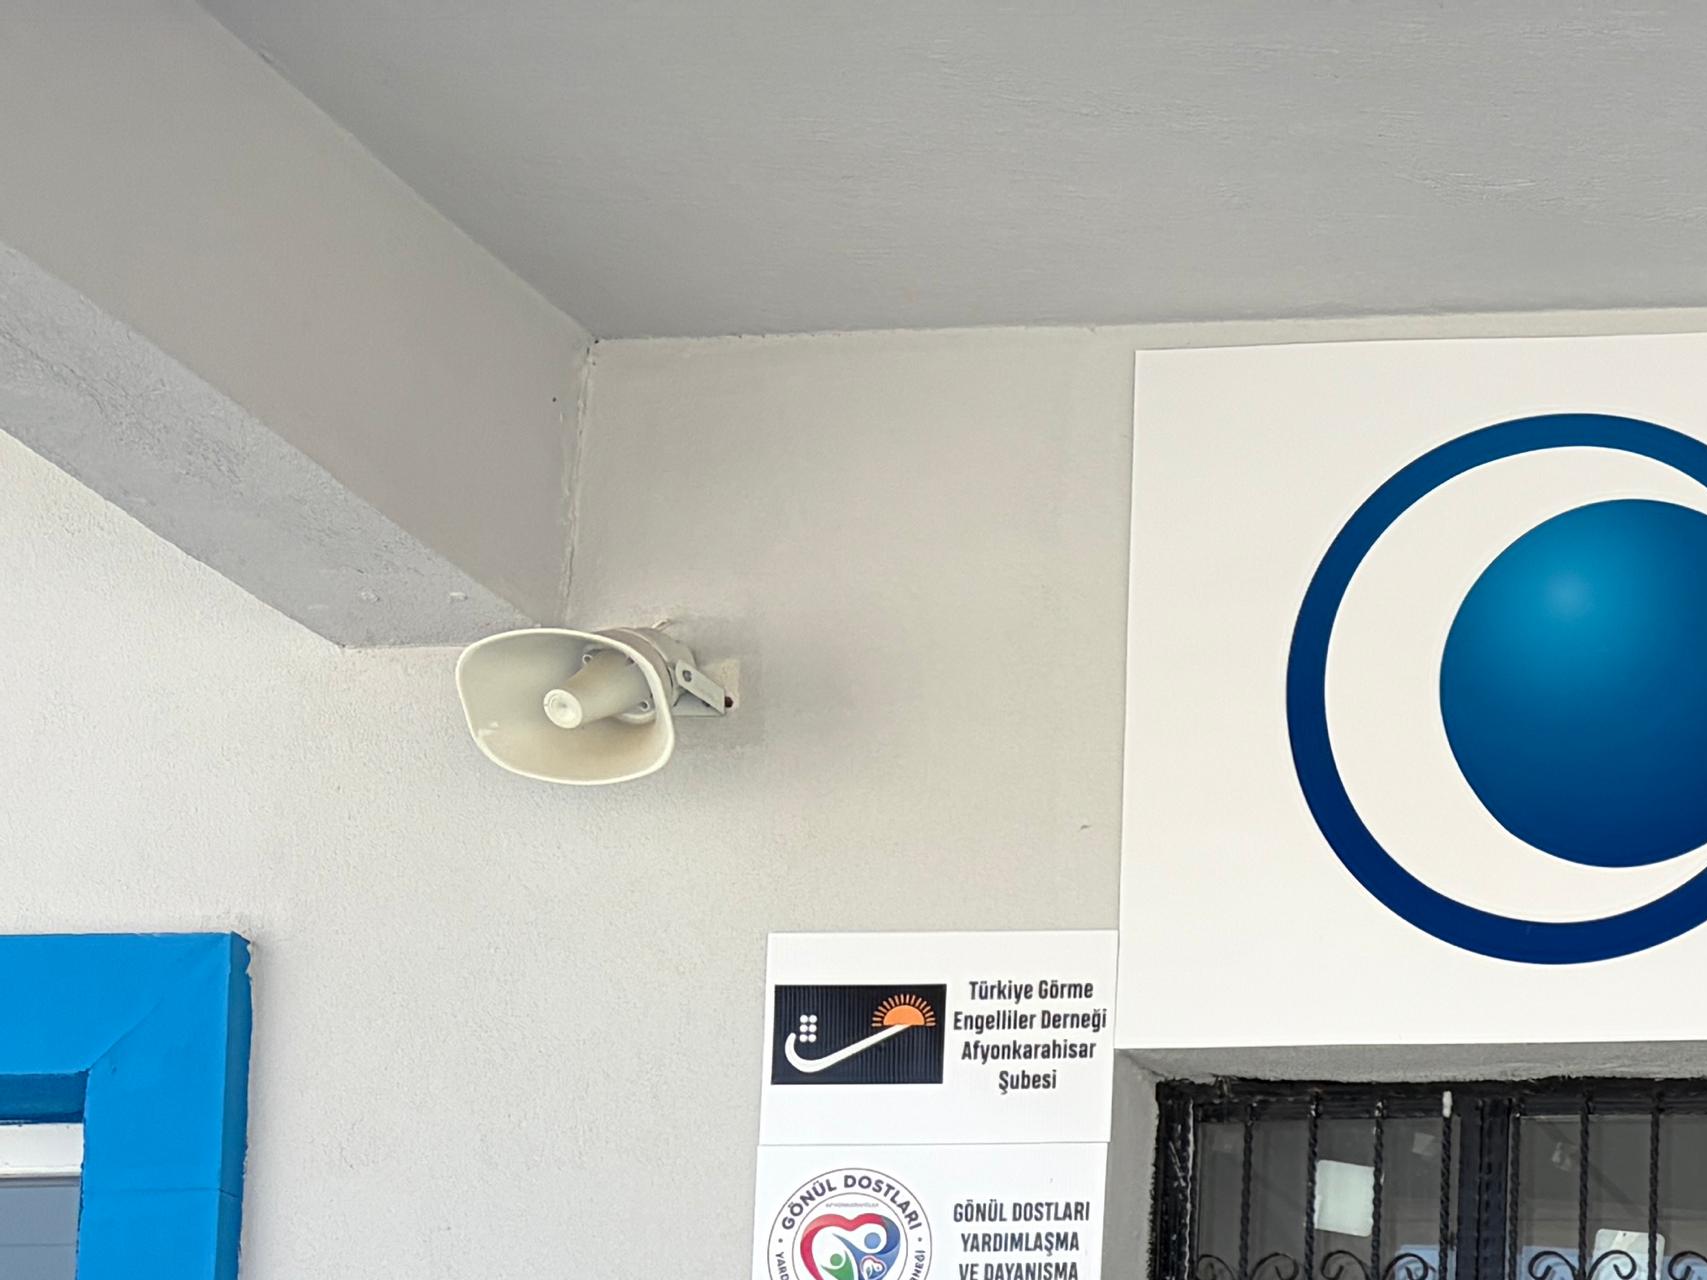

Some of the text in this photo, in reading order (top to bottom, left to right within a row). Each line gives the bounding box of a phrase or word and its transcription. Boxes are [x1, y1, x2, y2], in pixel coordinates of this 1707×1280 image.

[969, 979, 1094, 1004] Türkiye Görme
[953, 1008, 1107, 1034] Engelliler Derneği
[961, 1039, 1096, 1064] Afyonkarahisar
[999, 1069, 1057, 1095] Şubesi
[782, 1175, 922, 1230] GÖNÜL DOSTLARI
[953, 1199, 1090, 1222] GÖNÜL DOSTLARI
[961, 1232, 1079, 1256] YARDIMLAŞMA
